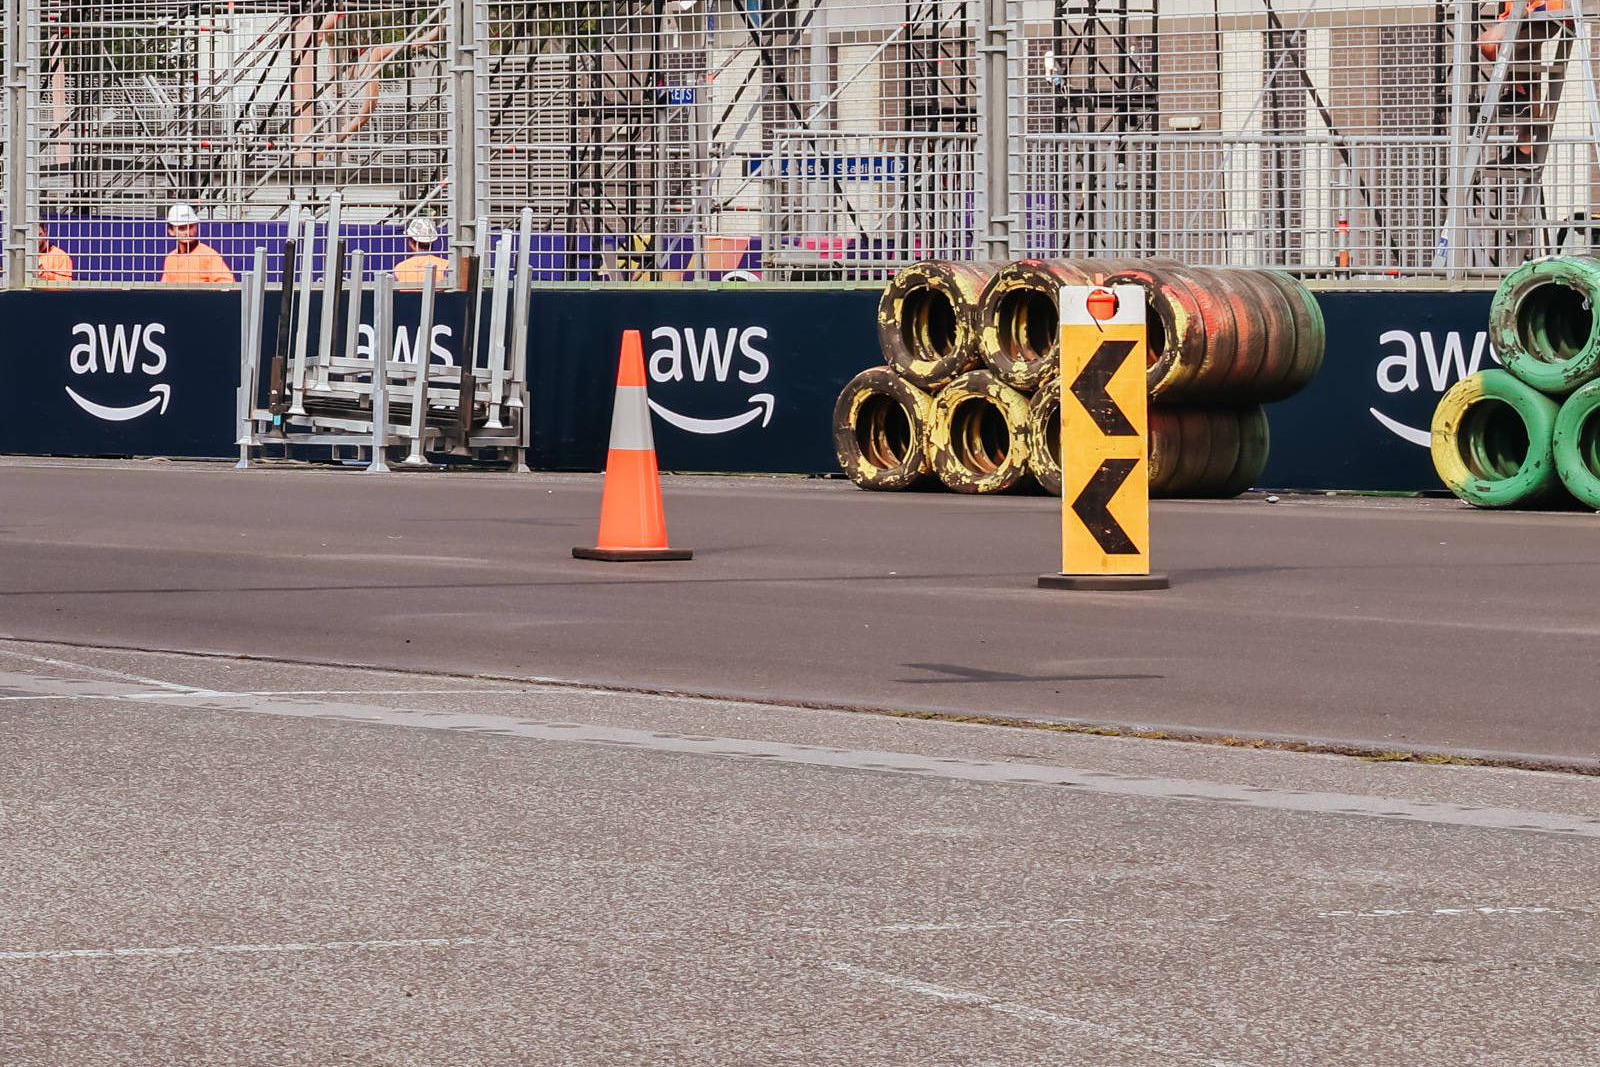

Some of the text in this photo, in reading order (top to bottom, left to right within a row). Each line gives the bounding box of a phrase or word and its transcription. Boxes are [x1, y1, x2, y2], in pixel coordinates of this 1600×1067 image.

[69, 322, 167, 375] aws
[649, 326, 770, 384] aws
[1376, 329, 1502, 393] aw
